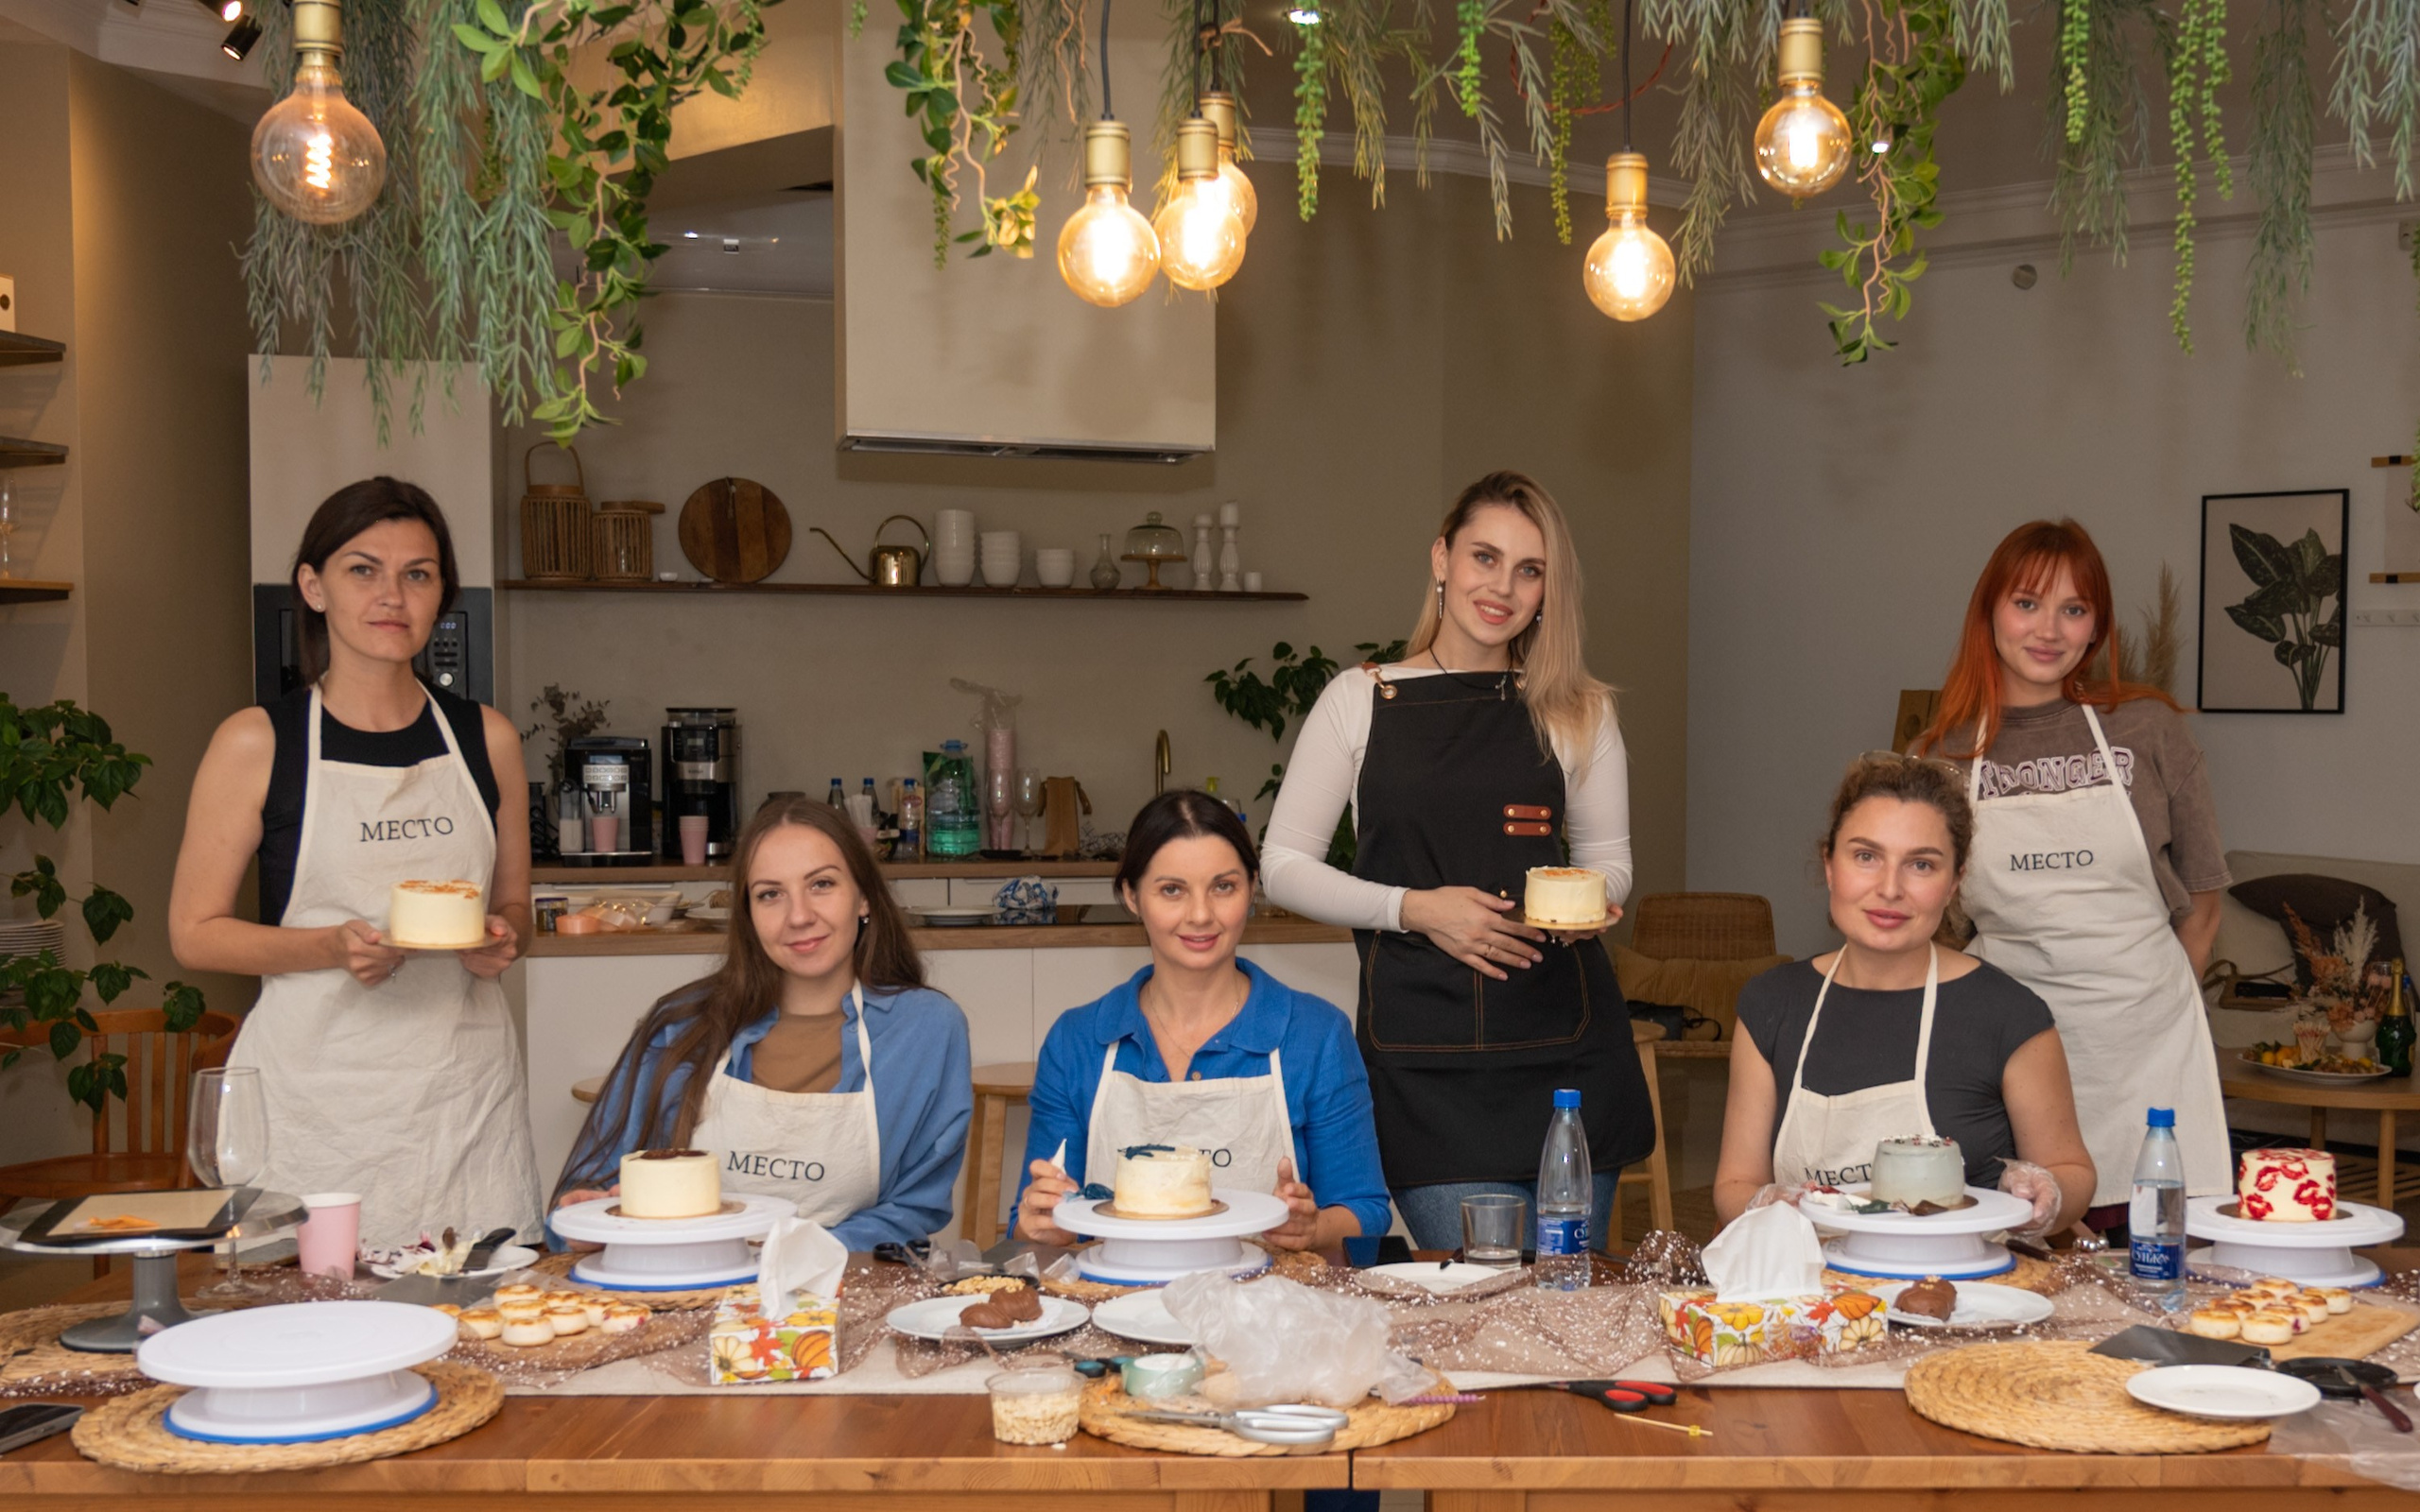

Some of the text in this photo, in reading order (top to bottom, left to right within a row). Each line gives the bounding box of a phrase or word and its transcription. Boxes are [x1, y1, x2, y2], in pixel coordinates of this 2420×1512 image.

[1964, 746, 2135, 799] TRONGER
[359, 816, 454, 842] МЕСТО
[2010, 850, 2094, 871] МЕСТО
[726, 1150, 825, 1182] МЕСТО
[1804, 1162, 1872, 1186] МЕСТ
